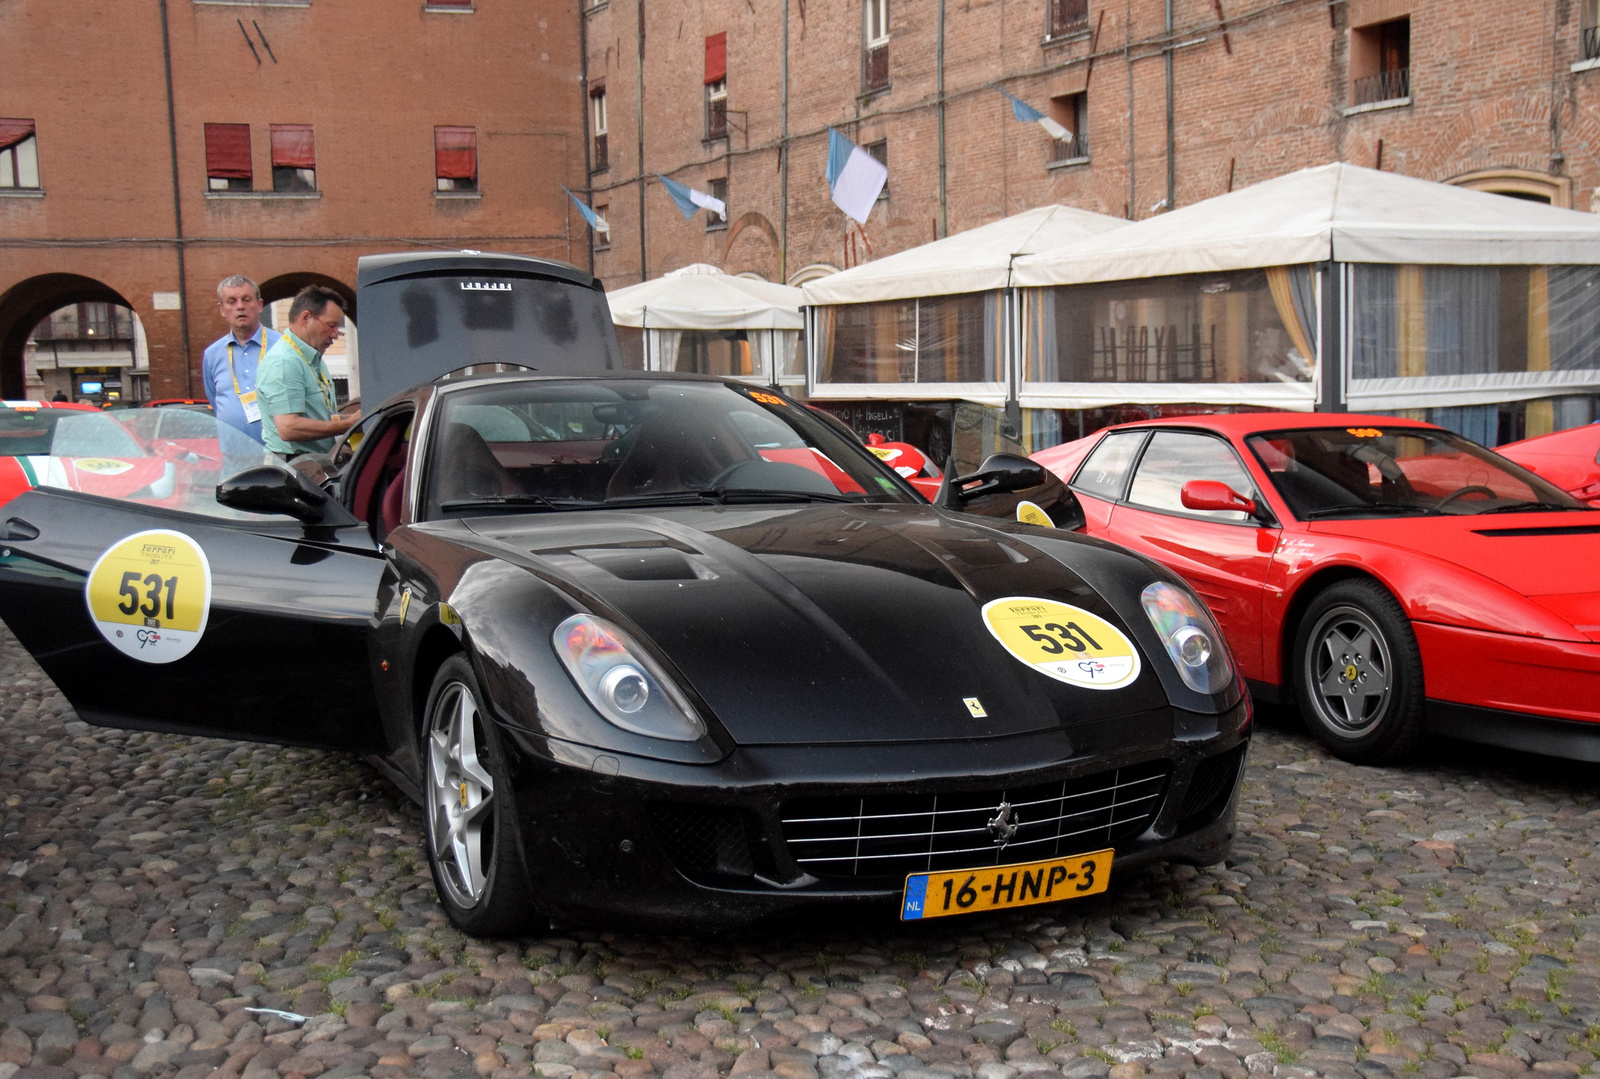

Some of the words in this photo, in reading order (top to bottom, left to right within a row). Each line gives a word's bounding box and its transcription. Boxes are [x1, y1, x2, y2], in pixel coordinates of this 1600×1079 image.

[748, 391, 788, 407] 531
[141, 544, 176, 555] Ferrari
[141, 553, 174, 561] TRIBUTE
[118, 571, 178, 620] 531
[1019, 622, 1104, 655] 531
[943, 860, 1096, 910] 16-HNP-3
[906, 901, 921, 911] NL
